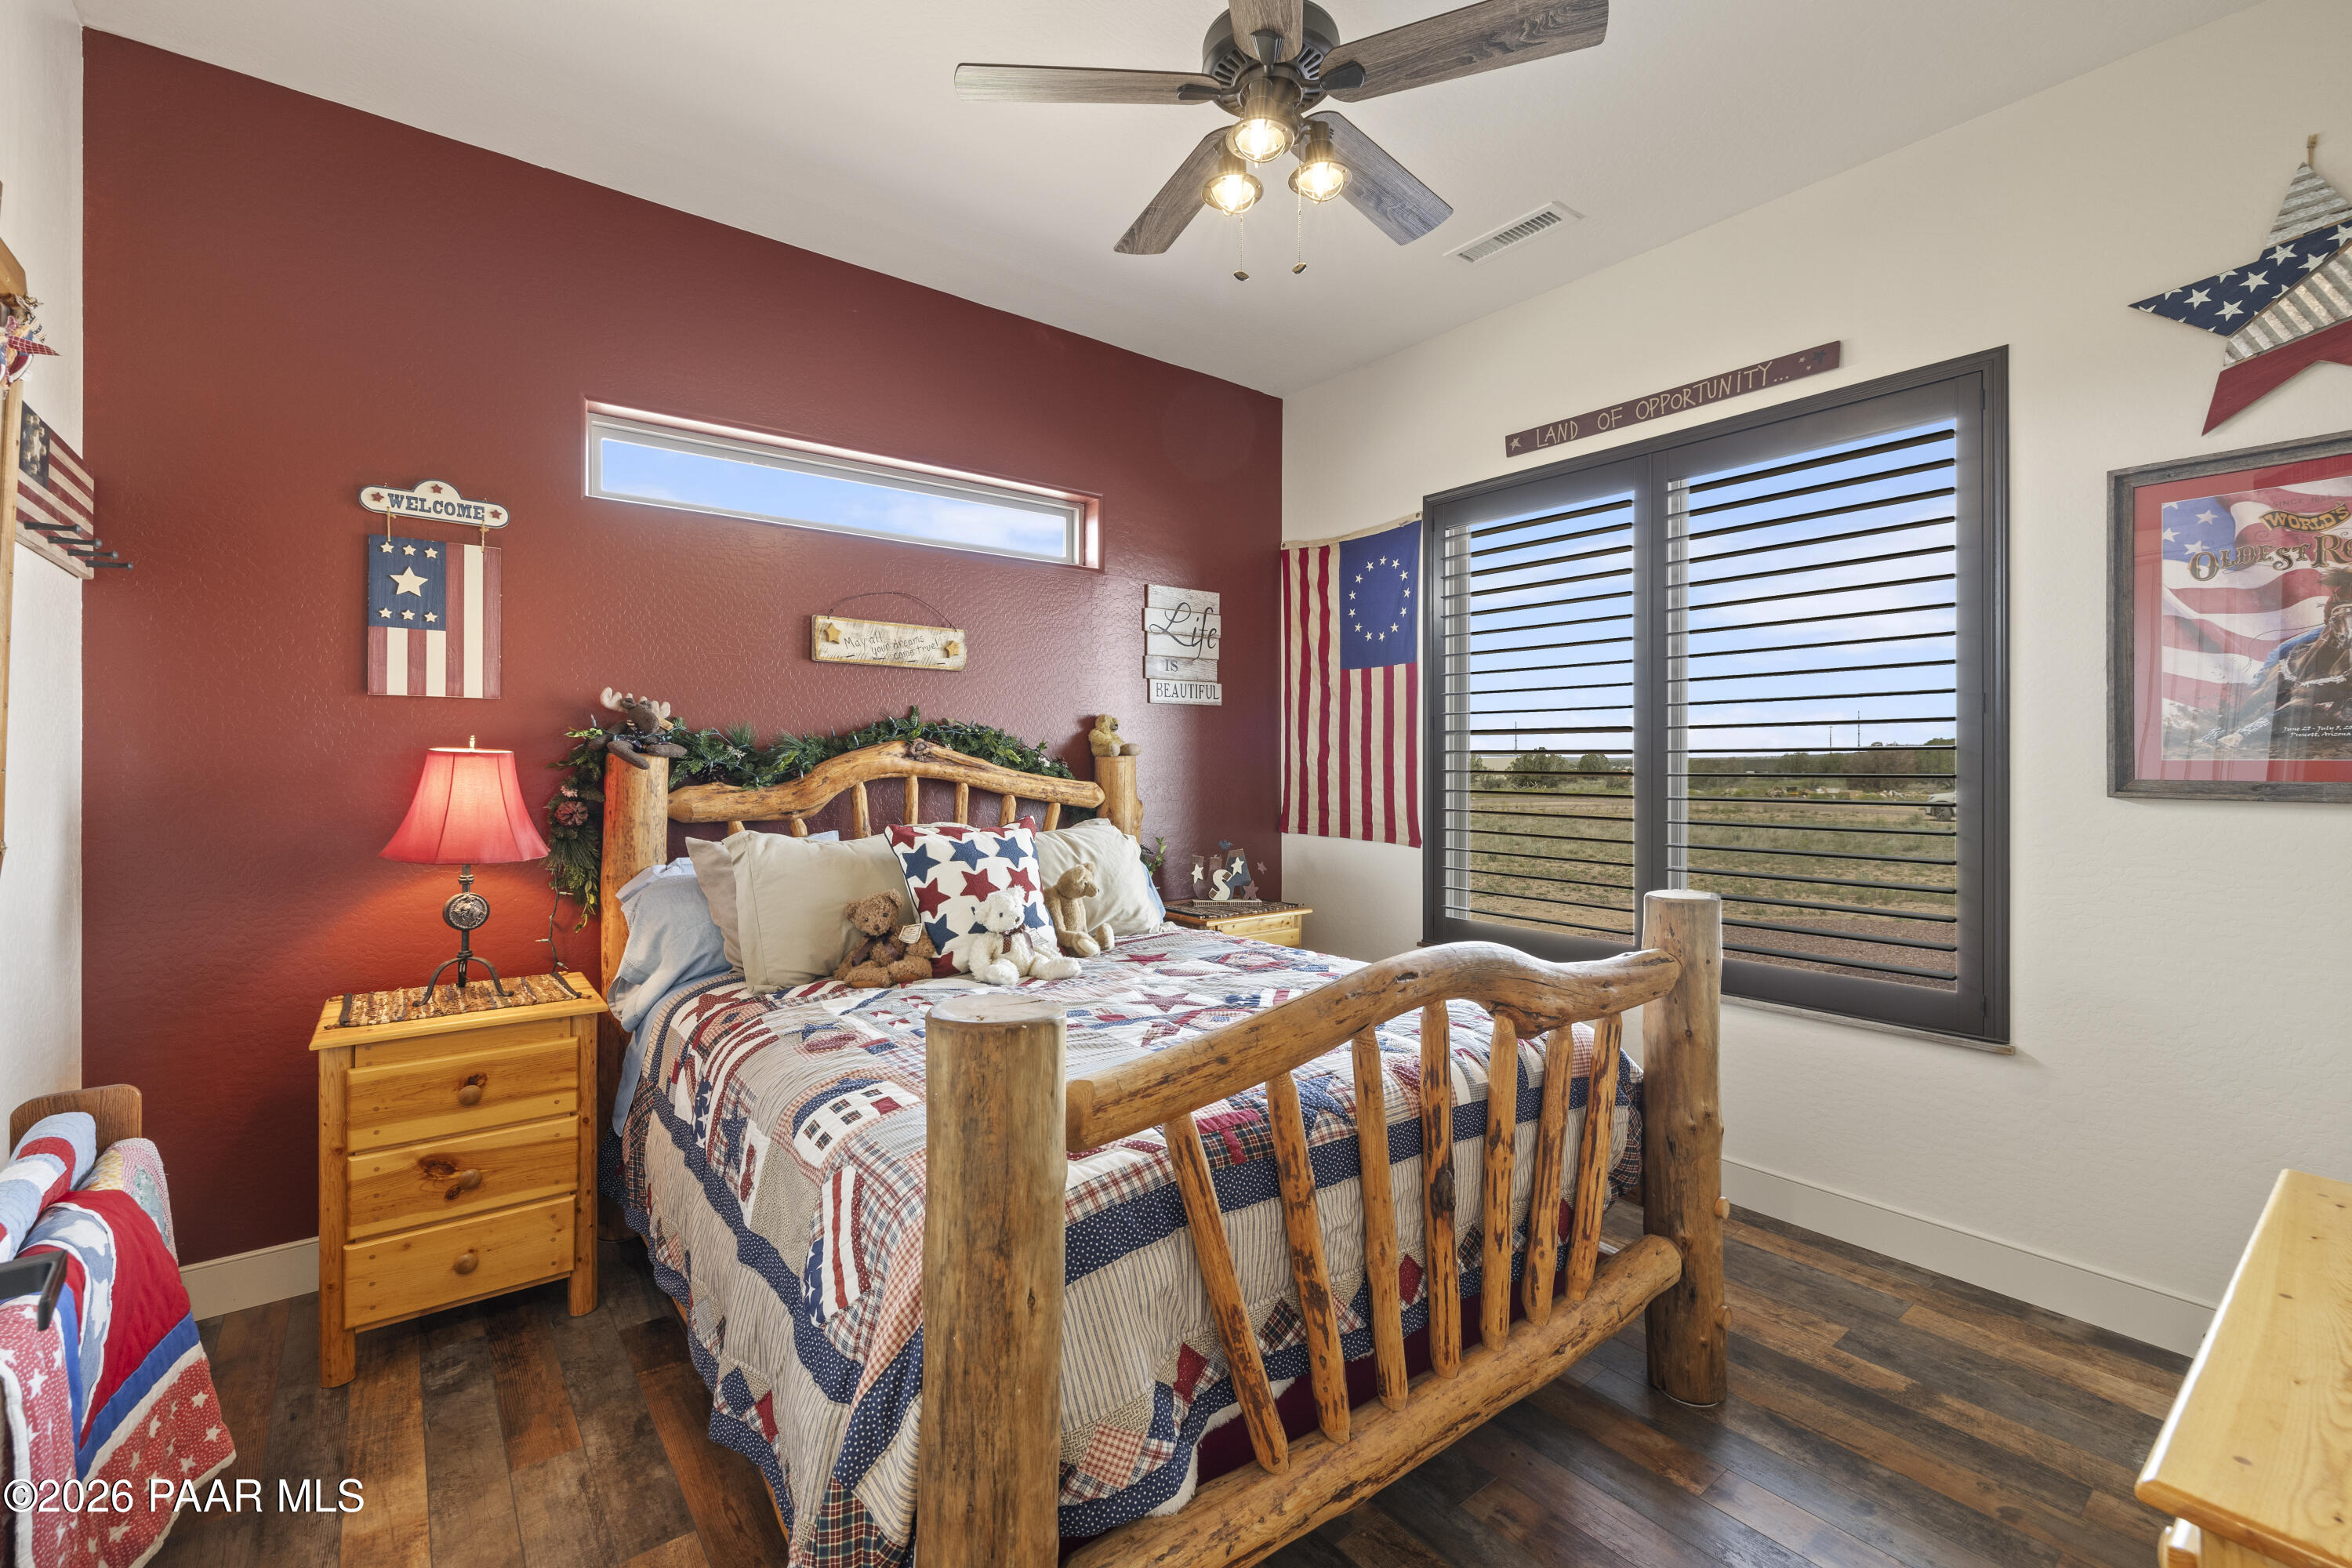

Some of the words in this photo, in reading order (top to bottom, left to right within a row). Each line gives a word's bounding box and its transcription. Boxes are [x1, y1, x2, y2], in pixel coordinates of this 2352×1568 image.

[1536, 420, 1579, 448] LAND
[1597, 406, 1623, 430] OF
[387, 492, 485, 521] WELCOME
[2272, 497, 2303, 508] SINCE
[2263, 506, 2350, 531] WORLD'S
[2187, 543, 2312, 582] OLDEST
[844, 637, 866, 650] May
[869, 630, 883, 644] all
[1149, 601, 1218, 661] Life
[871, 643, 890, 660] your
[893, 635, 924, 650] dreams
[893, 649, 914, 660] come
[916, 637, 940, 653] true!
[1165, 659, 1178, 673] IS
[1156, 682, 1220, 700] BEAUTIFUL
[1192, 848, 1252, 900] USA
